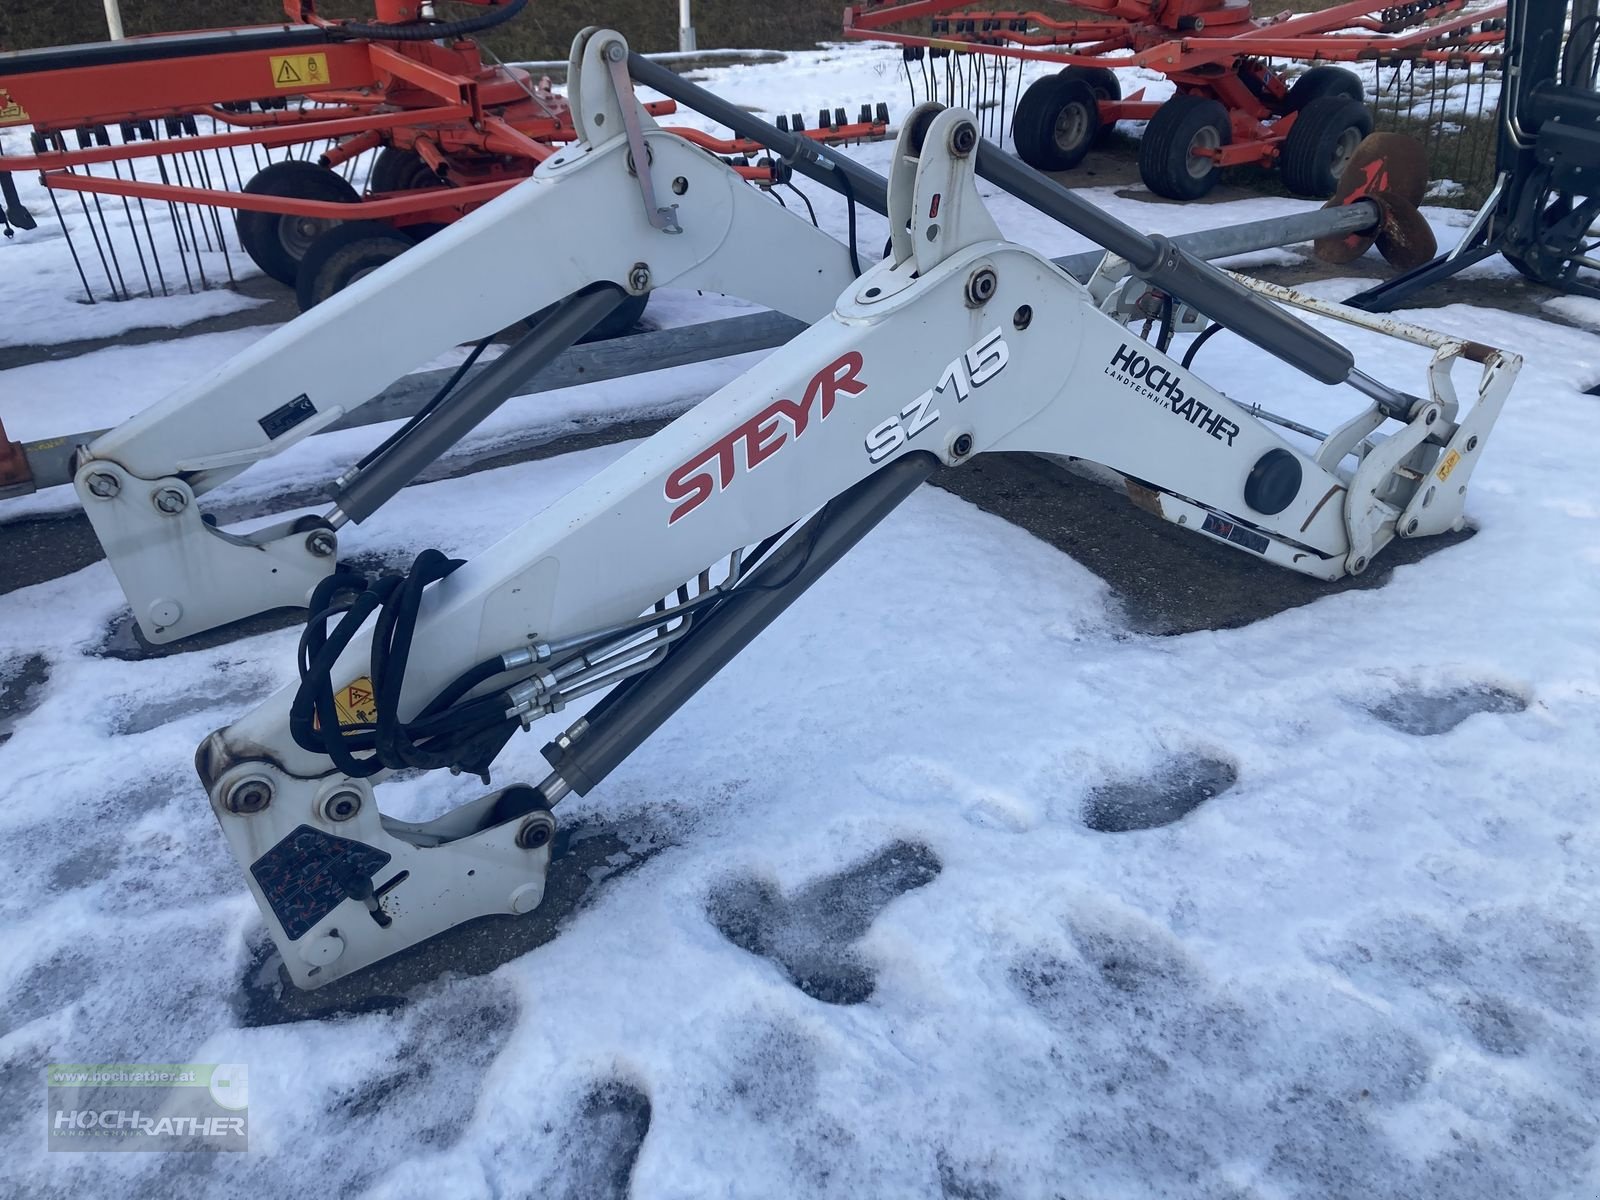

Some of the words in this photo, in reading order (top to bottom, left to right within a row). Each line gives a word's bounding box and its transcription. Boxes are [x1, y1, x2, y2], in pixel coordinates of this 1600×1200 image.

[664, 350, 868, 526] STEYR
[1104, 367, 1170, 409] LANDTECHNIK
[1110, 343, 1240, 447] HOCHRATHER
